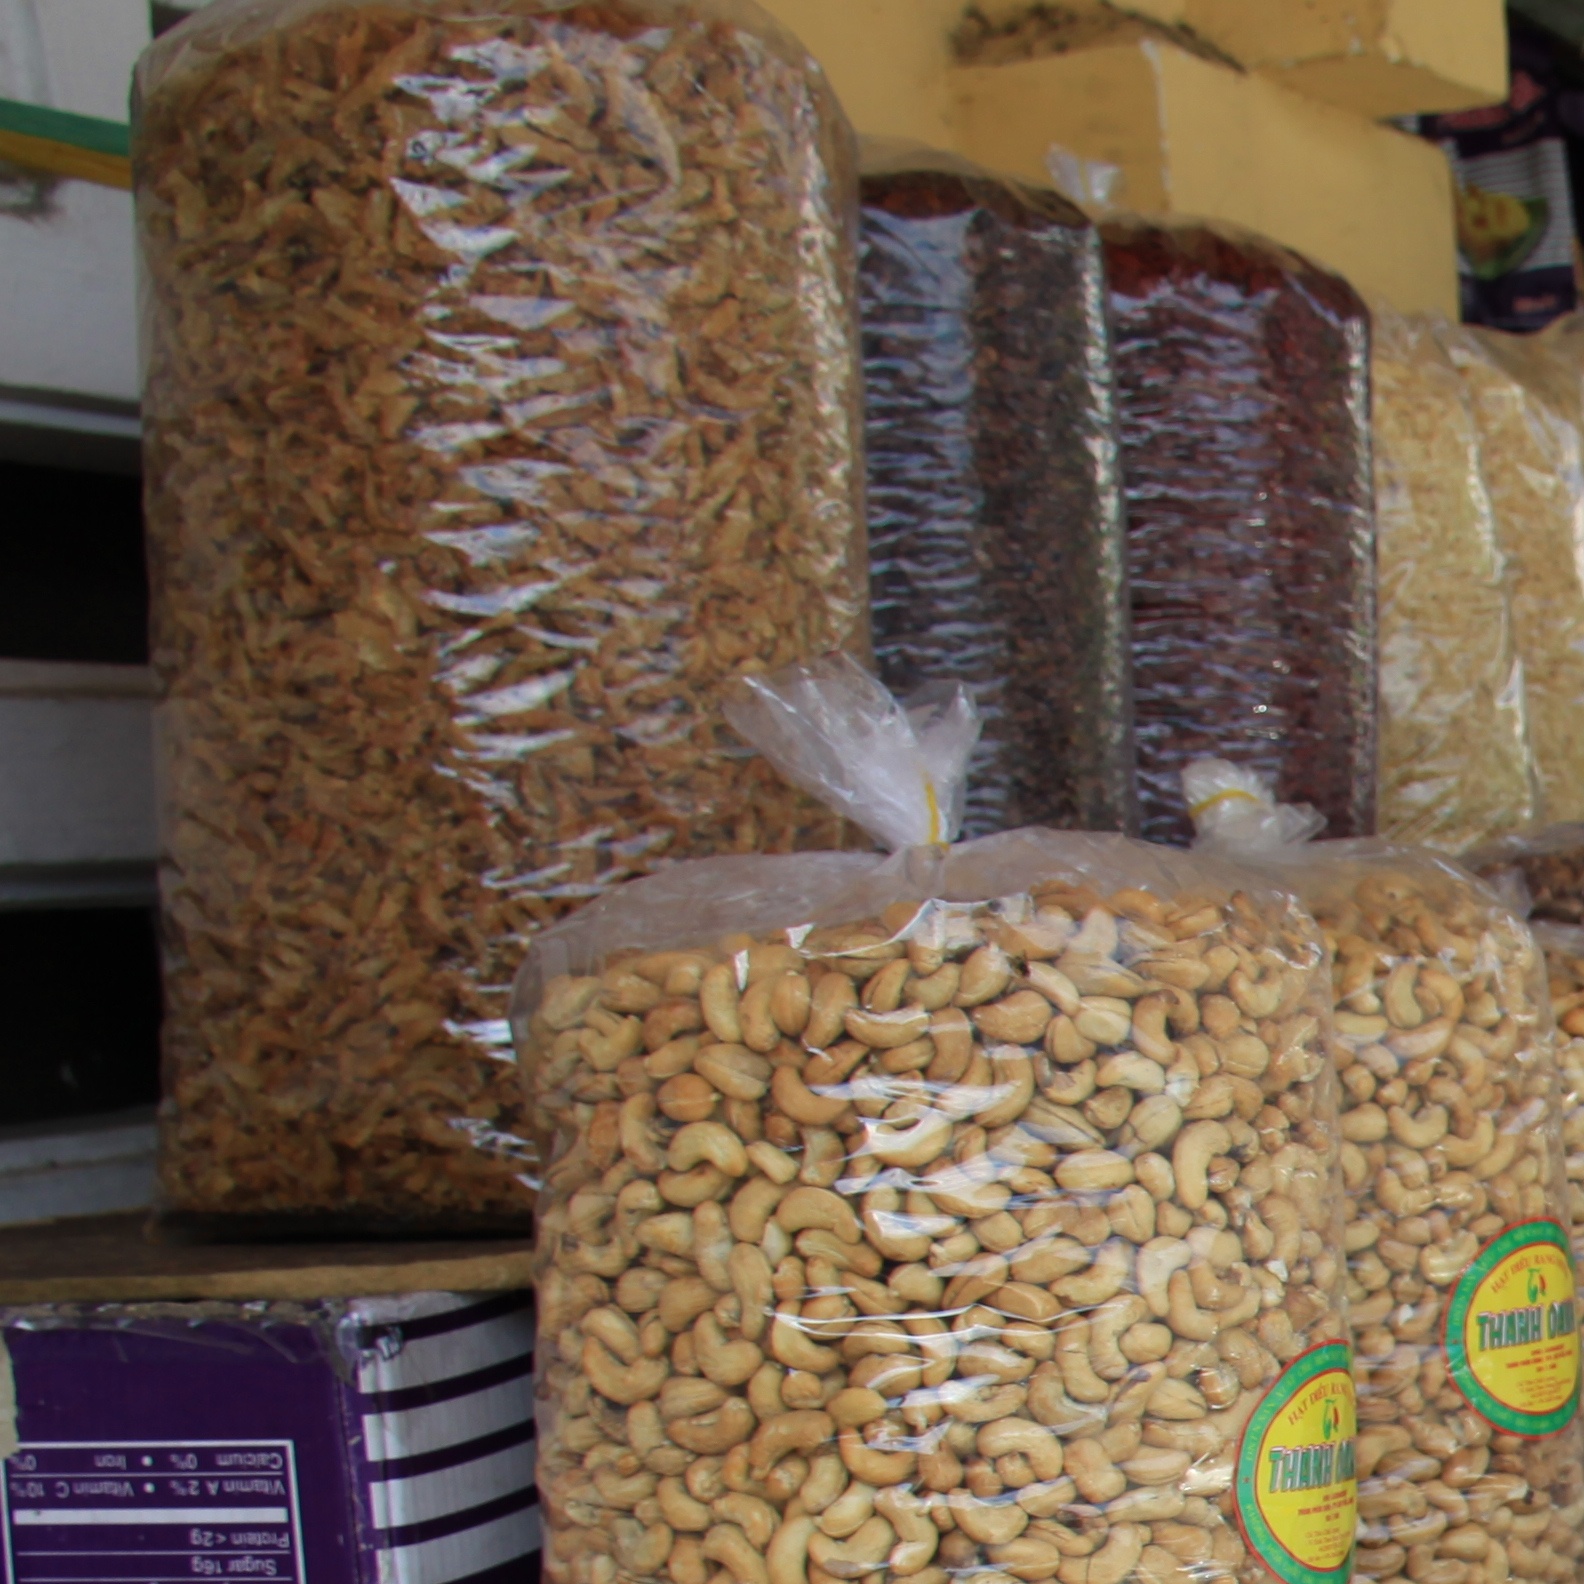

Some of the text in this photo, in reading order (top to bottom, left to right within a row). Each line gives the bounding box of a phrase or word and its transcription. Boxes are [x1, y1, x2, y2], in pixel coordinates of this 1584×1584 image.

[1477, 1304, 1544, 1351] THANH
[1270, 1442, 1335, 1493] THANH
[10, 1479, 284, 1498] Vitamin A 2% Vitamin C 10%
[231, 1532, 289, 1547] Protein
[191, 1555, 277, 1575] Sugar 16g
